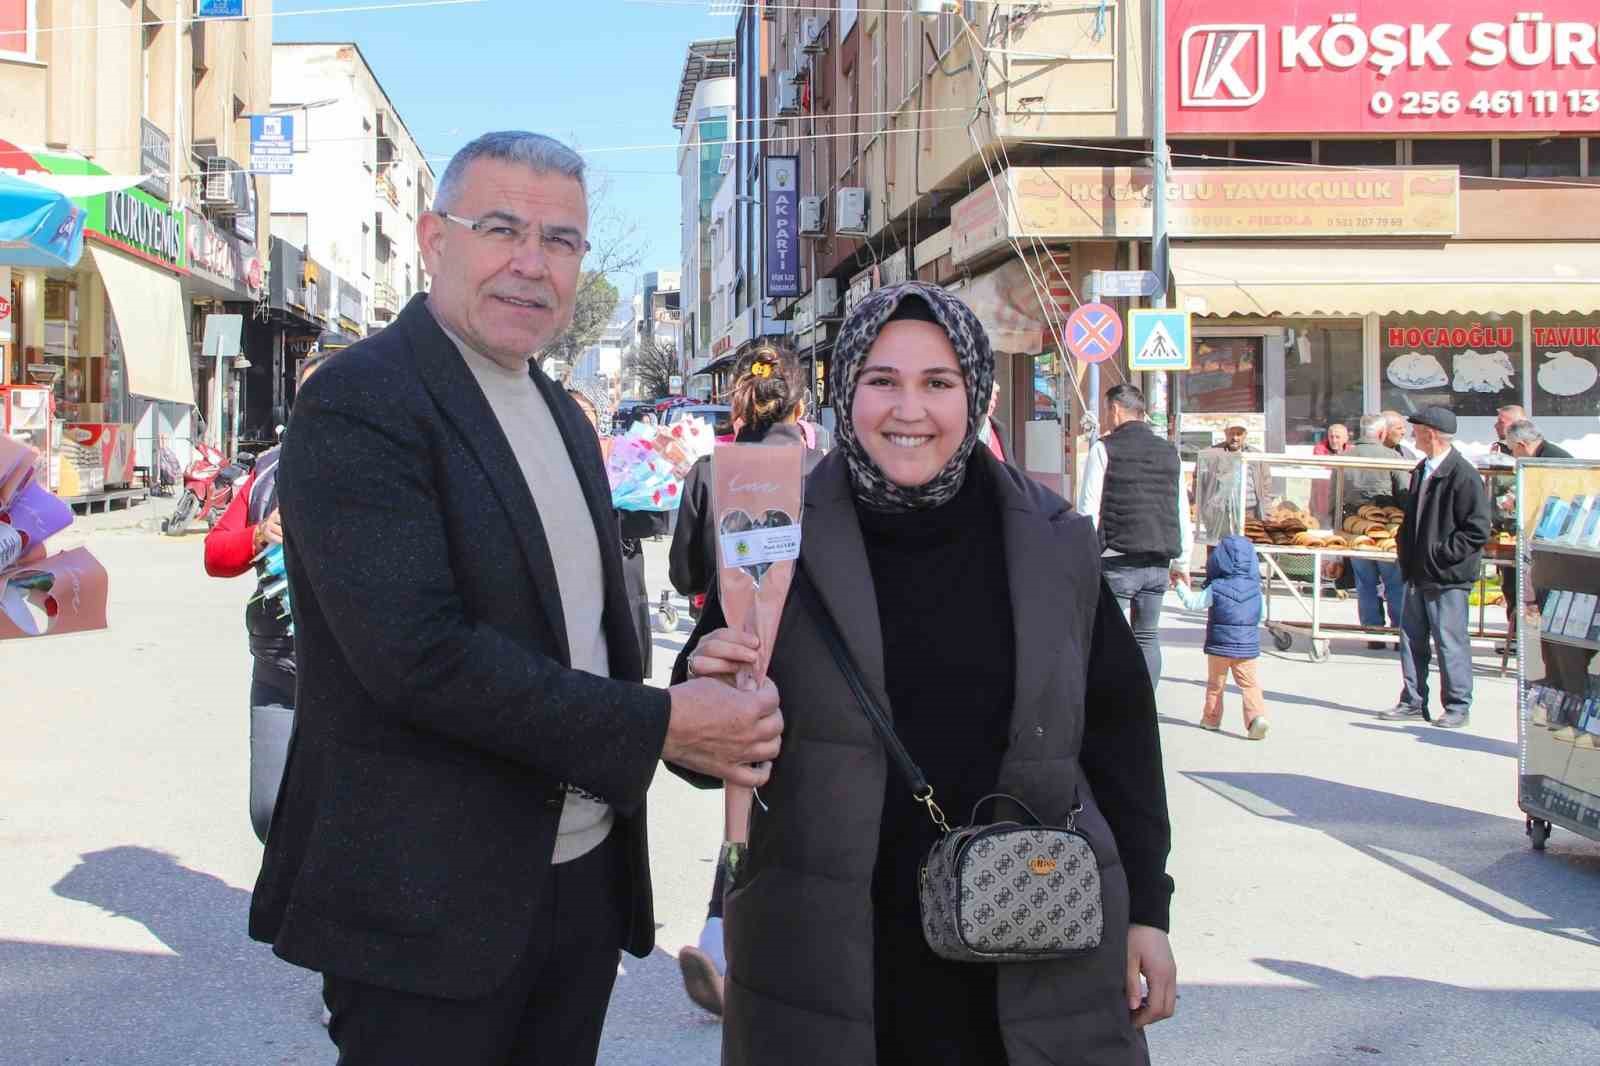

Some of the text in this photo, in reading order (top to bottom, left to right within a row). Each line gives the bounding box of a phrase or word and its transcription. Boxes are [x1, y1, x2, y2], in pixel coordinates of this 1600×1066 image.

[1280, 12, 1600, 77] KÖŞK SÜR
[1370, 89, 1600, 114] 0 256 461 11 13
[775, 194, 790, 215] AK
[1388, 321, 1514, 348] HOCAOĞLU
